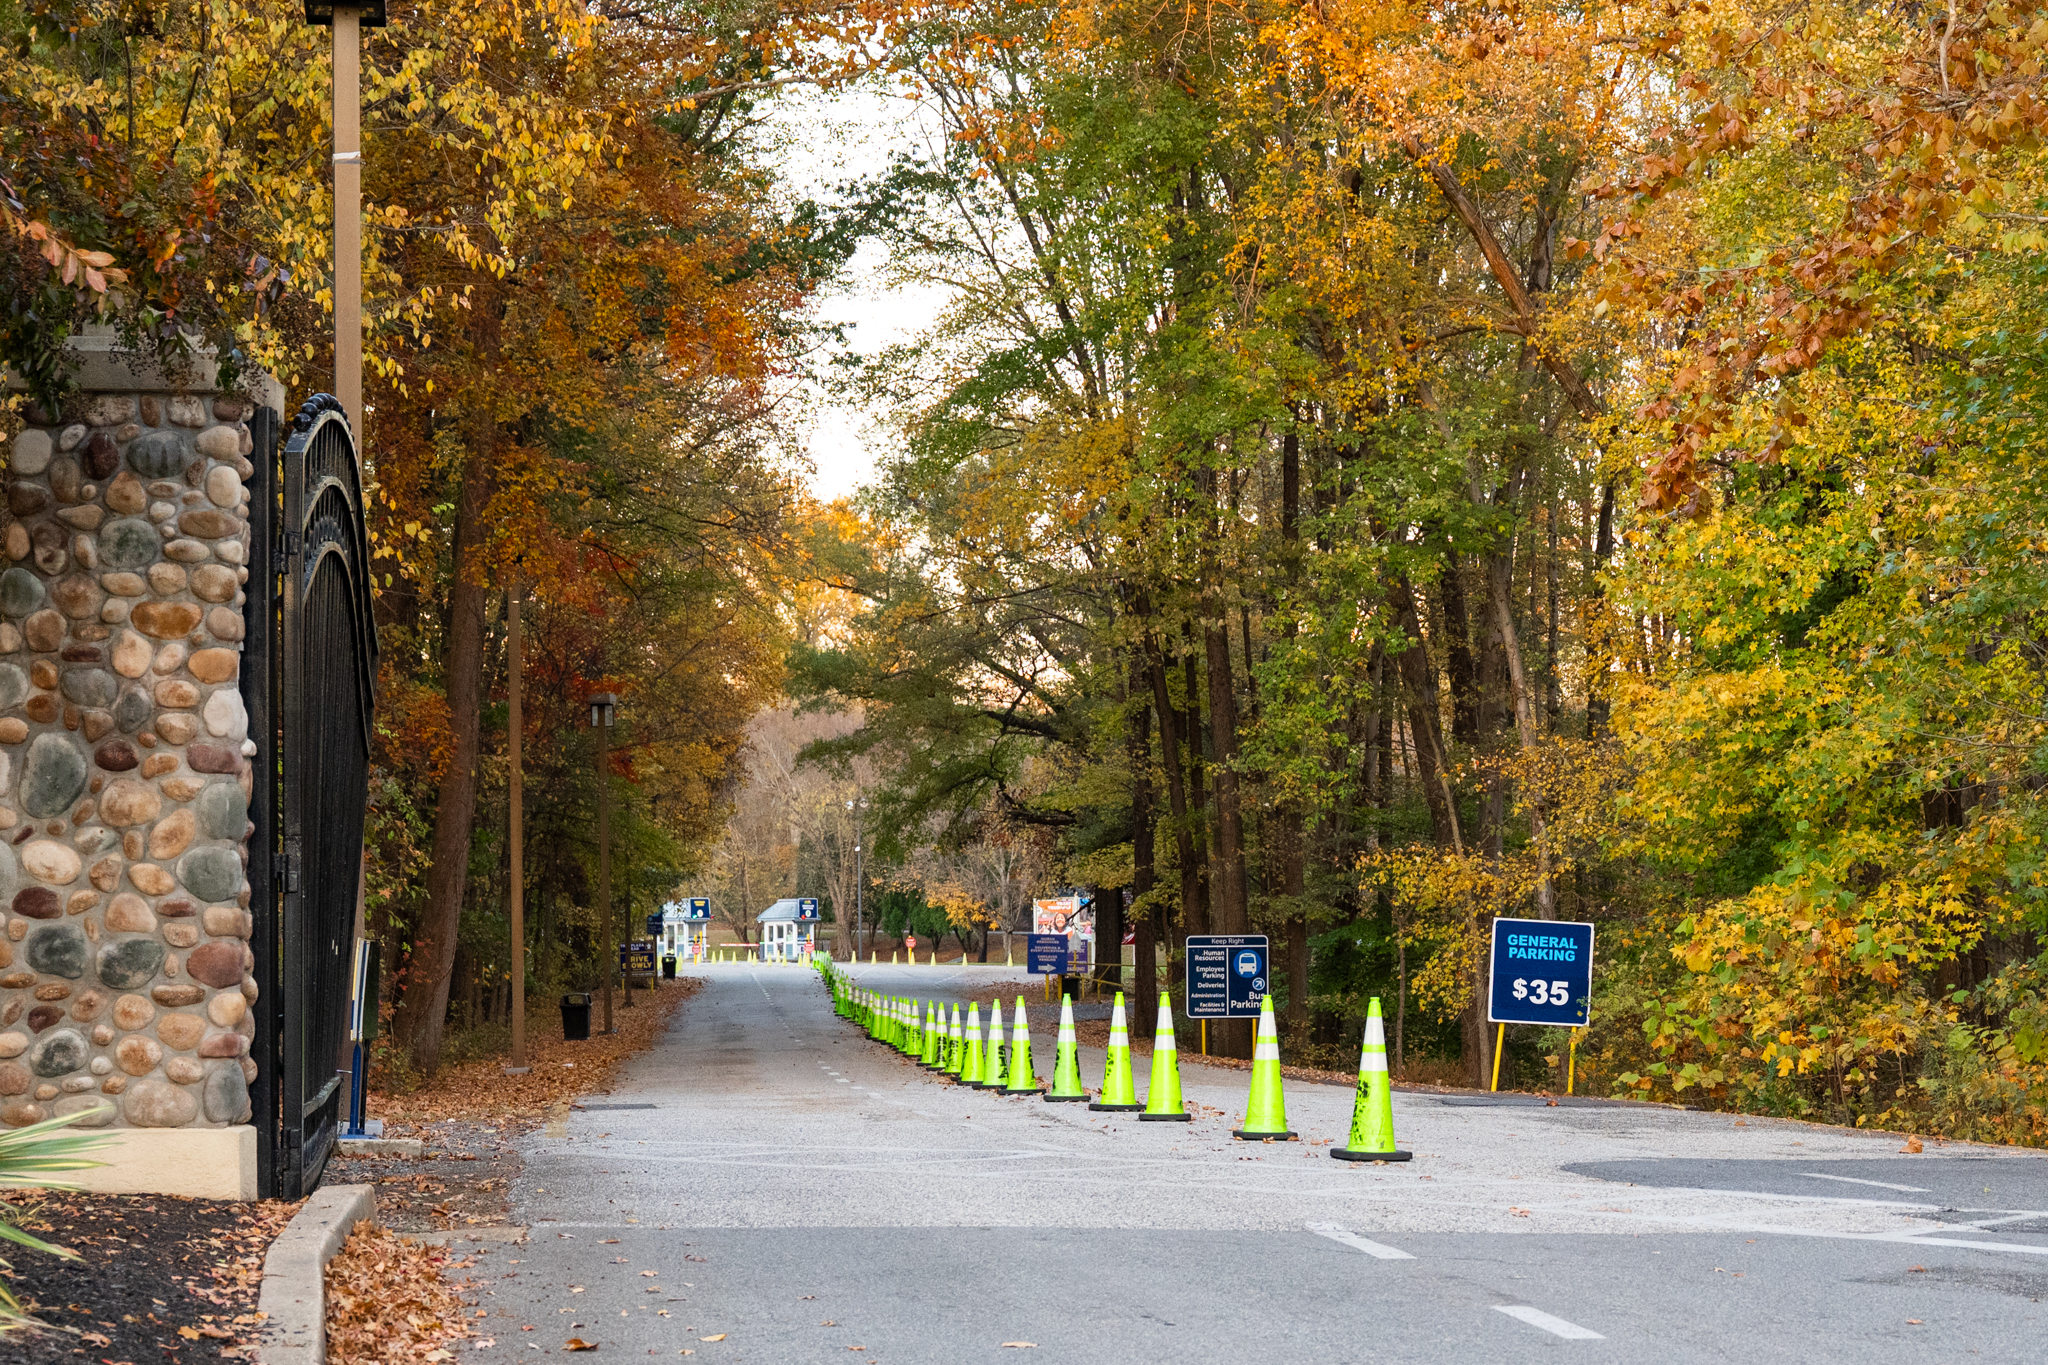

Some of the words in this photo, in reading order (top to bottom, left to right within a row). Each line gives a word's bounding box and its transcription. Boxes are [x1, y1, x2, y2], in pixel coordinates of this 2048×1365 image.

[1507, 934, 1578, 949] GENERAL
[1508, 947, 1576, 962] PARKING
[622, 961, 652, 969] SOWLY
[1512, 977, 1569, 1006] $35
